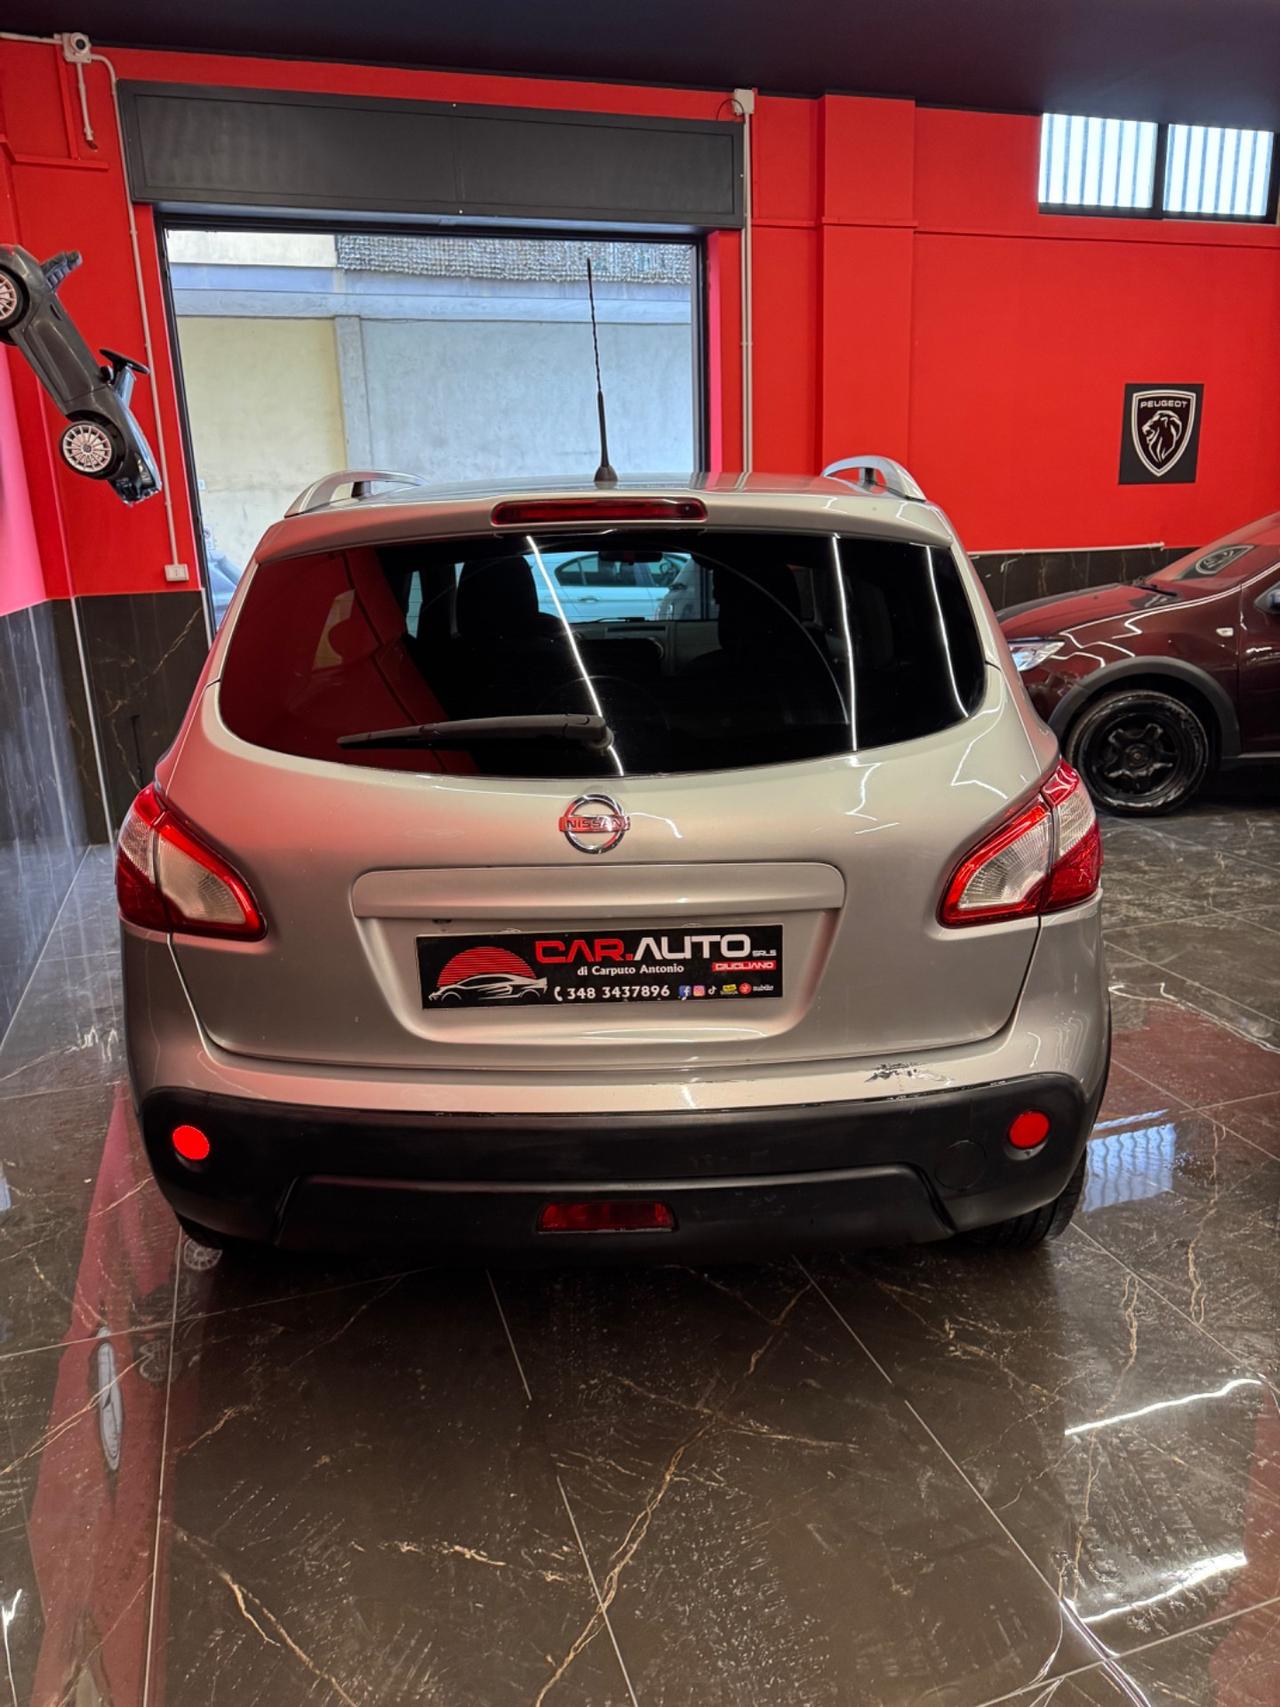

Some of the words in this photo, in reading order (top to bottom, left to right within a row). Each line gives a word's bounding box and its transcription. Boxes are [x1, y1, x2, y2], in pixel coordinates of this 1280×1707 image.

[1140, 400, 1188, 408] PEUGEOT
[566, 818, 622, 829] NISSAN
[577, 965, 588, 976] di
[592, 964, 636, 977] Carputo
[639, 962, 685, 974] Antonio
[567, 987, 596, 1000] 348
[602, 985, 670, 998] 3437896
